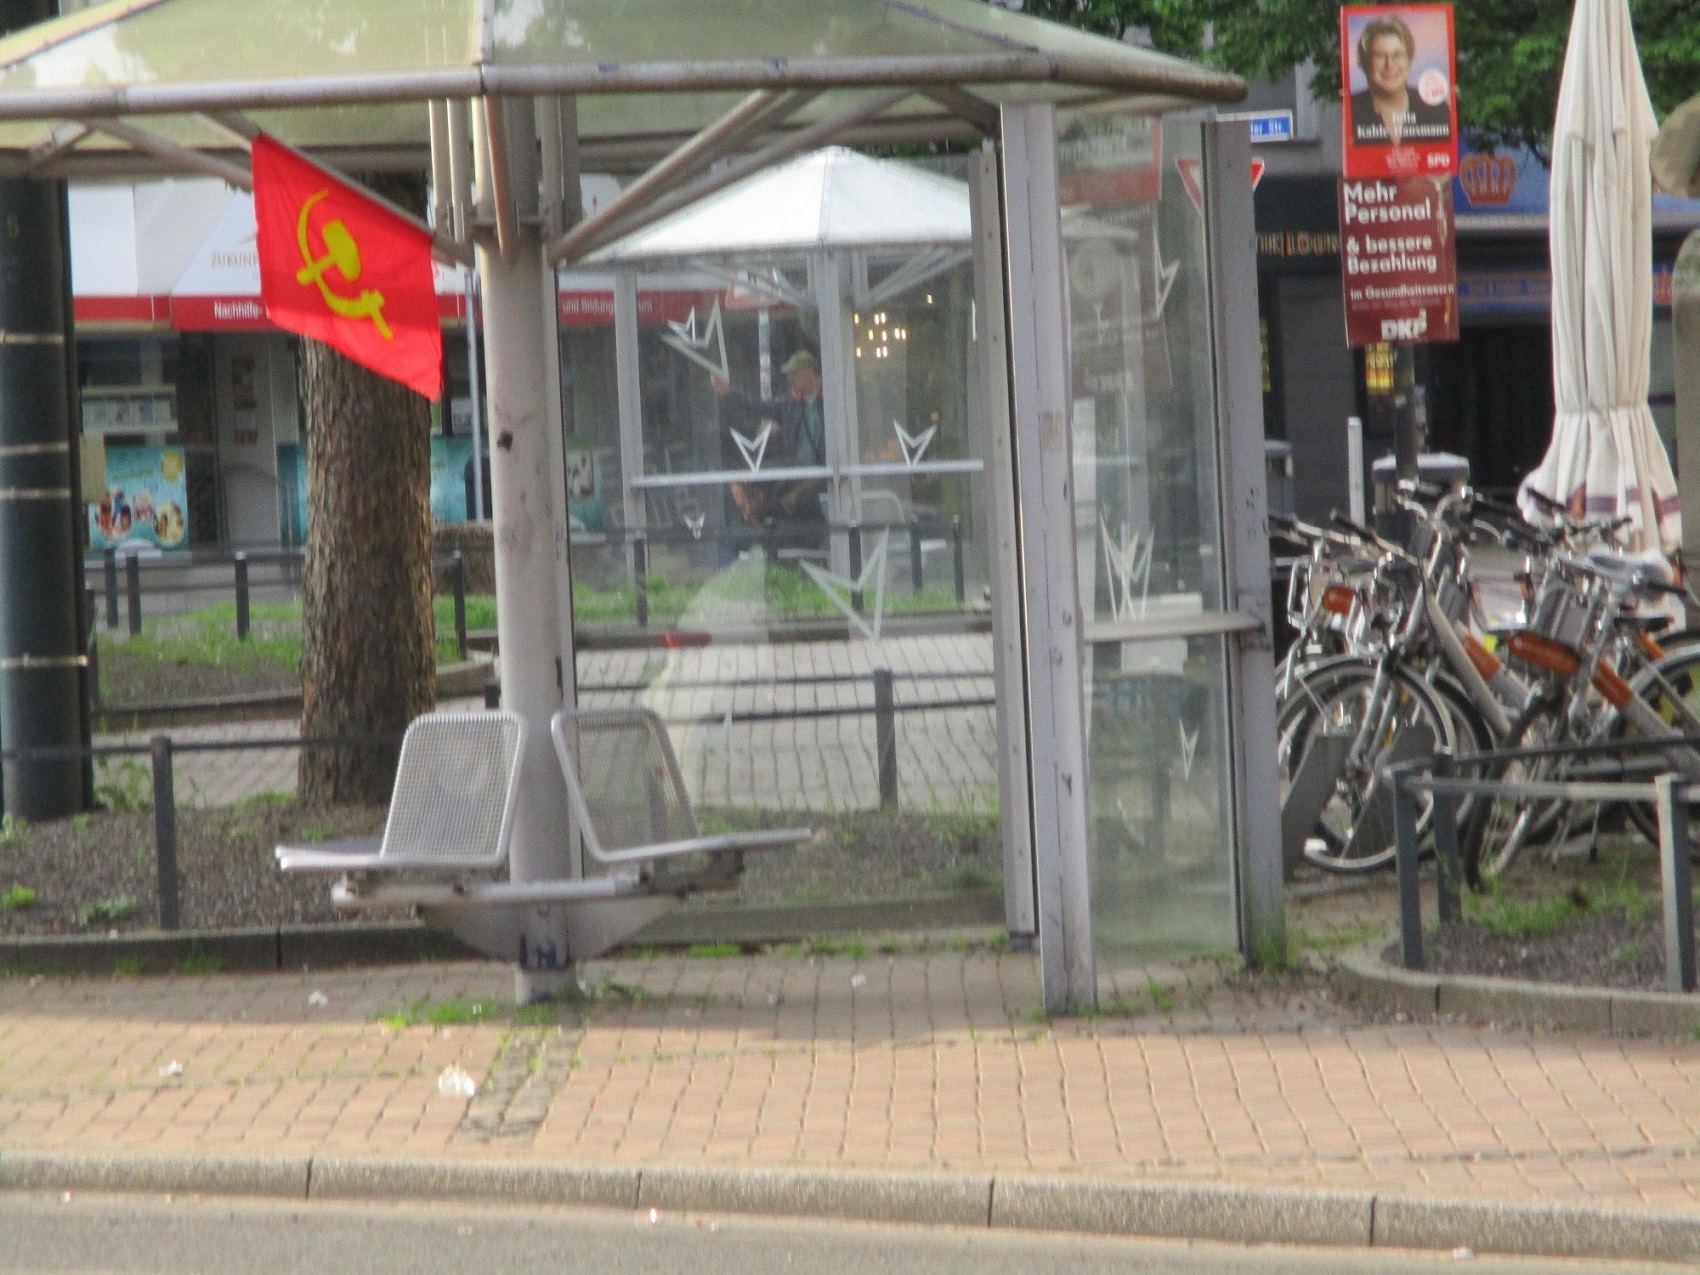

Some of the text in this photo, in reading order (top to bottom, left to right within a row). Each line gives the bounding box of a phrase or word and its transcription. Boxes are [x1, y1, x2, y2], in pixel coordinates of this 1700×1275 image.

[1427, 152, 1450, 168] SPD
[1343, 180, 1397, 204] Mehr
[1344, 196, 1432, 225] Personal
[1347, 233, 1433, 255] & bessere
[1347, 252, 1437, 275] Bezahlung
